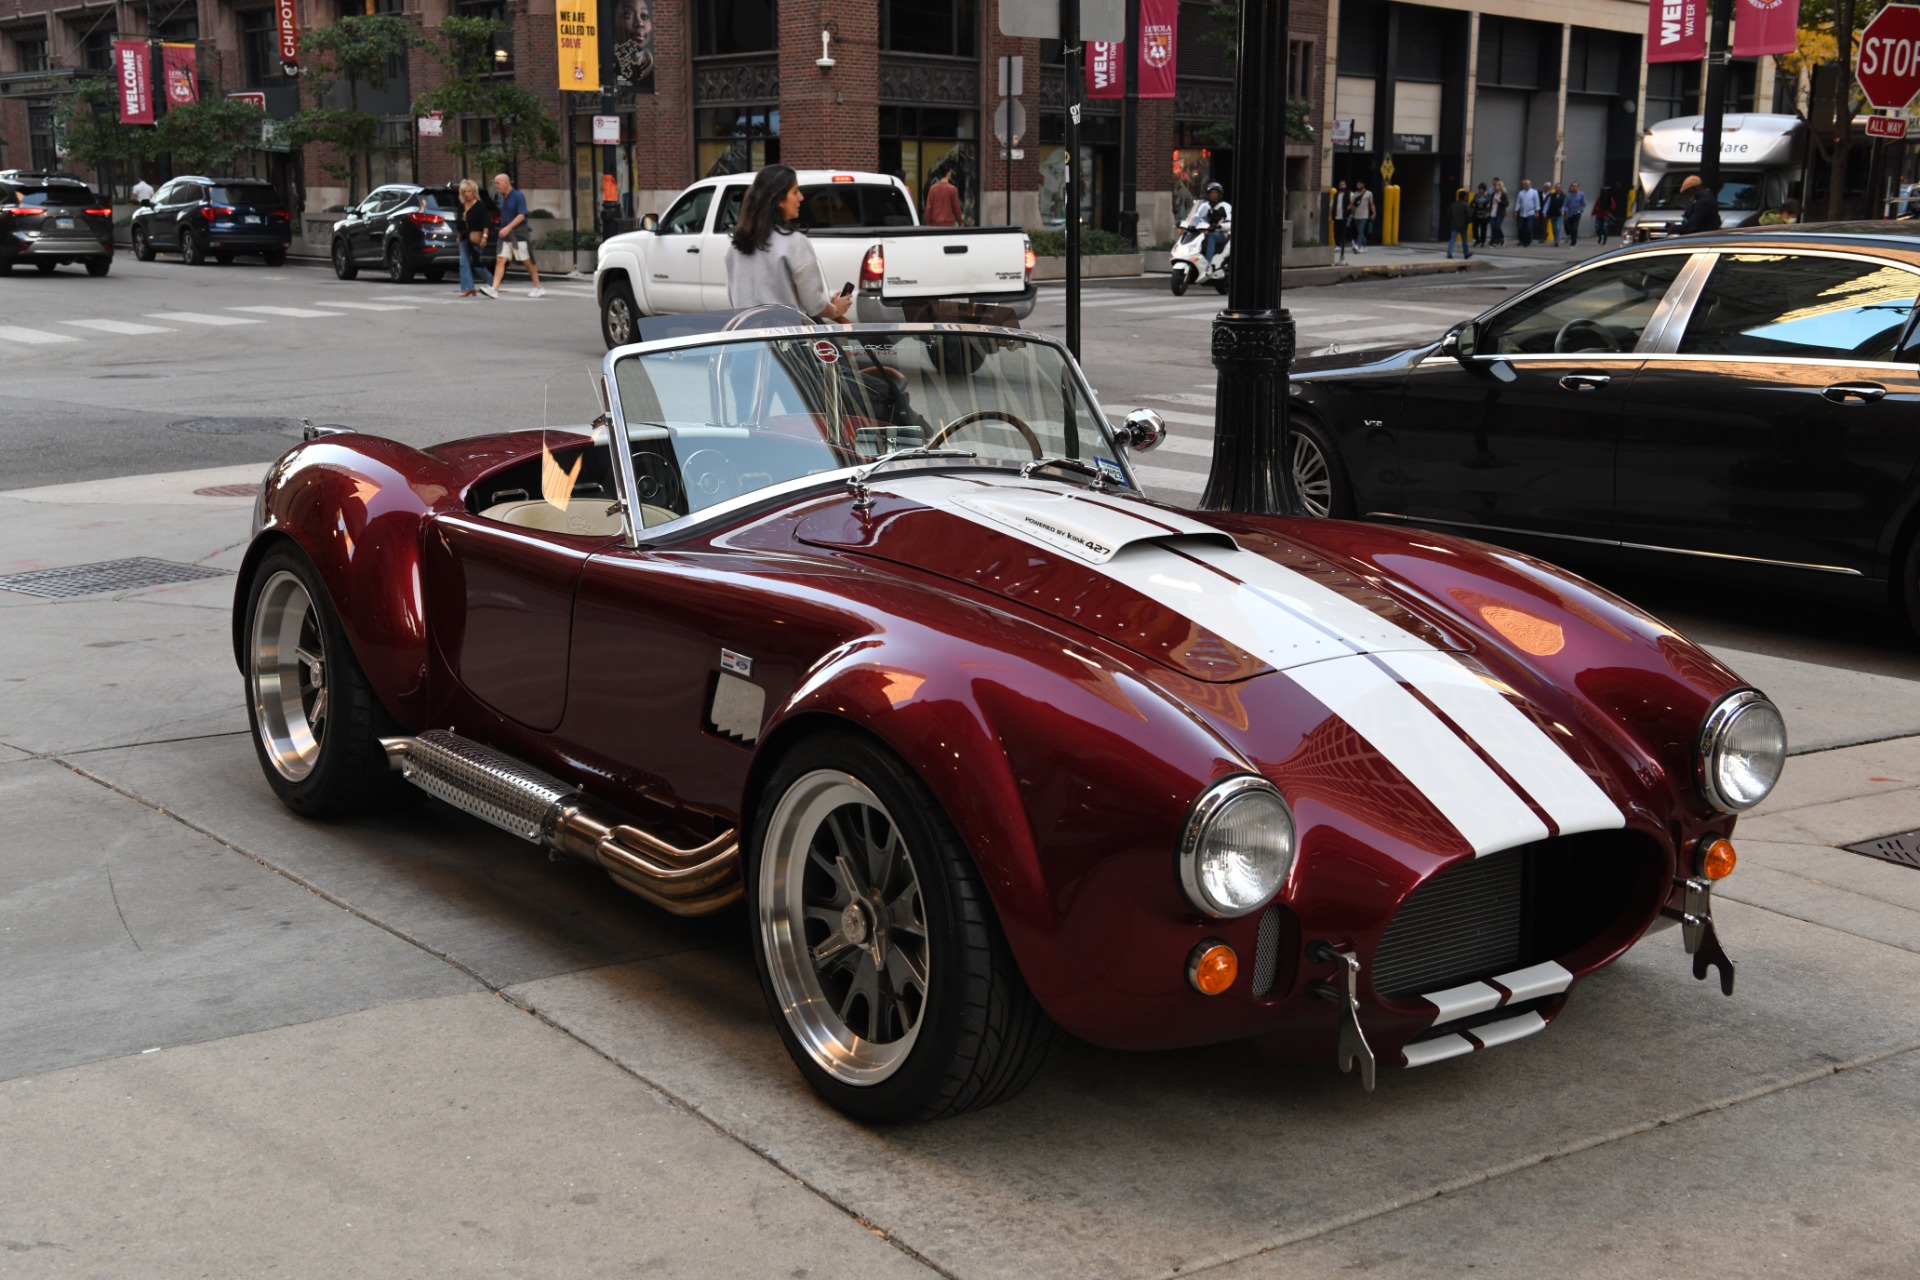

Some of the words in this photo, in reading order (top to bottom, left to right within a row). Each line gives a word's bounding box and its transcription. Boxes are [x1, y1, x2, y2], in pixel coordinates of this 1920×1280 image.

[560, 11, 571, 21] WE
[573, 12, 585, 22] ARE
[1684, 4, 1696, 37] WATER
[561, 25, 584, 36] CALLED
[586, 26, 595, 36] TO
[1144, 25, 1172, 33] LOYOLA
[561, 38, 582, 48] SOLVE
[1094, 42, 1108, 89] WELC
[1109, 61, 1117, 84] WATER
[122, 49, 139, 115] WELCOME
[1870, 120, 1885, 132] ALL
[1887, 122, 1903, 134] WAY
[1025, 516, 1056, 532] POWERED
[1057, 529, 1065, 537] BY
[1085, 541, 1111, 555] 427
